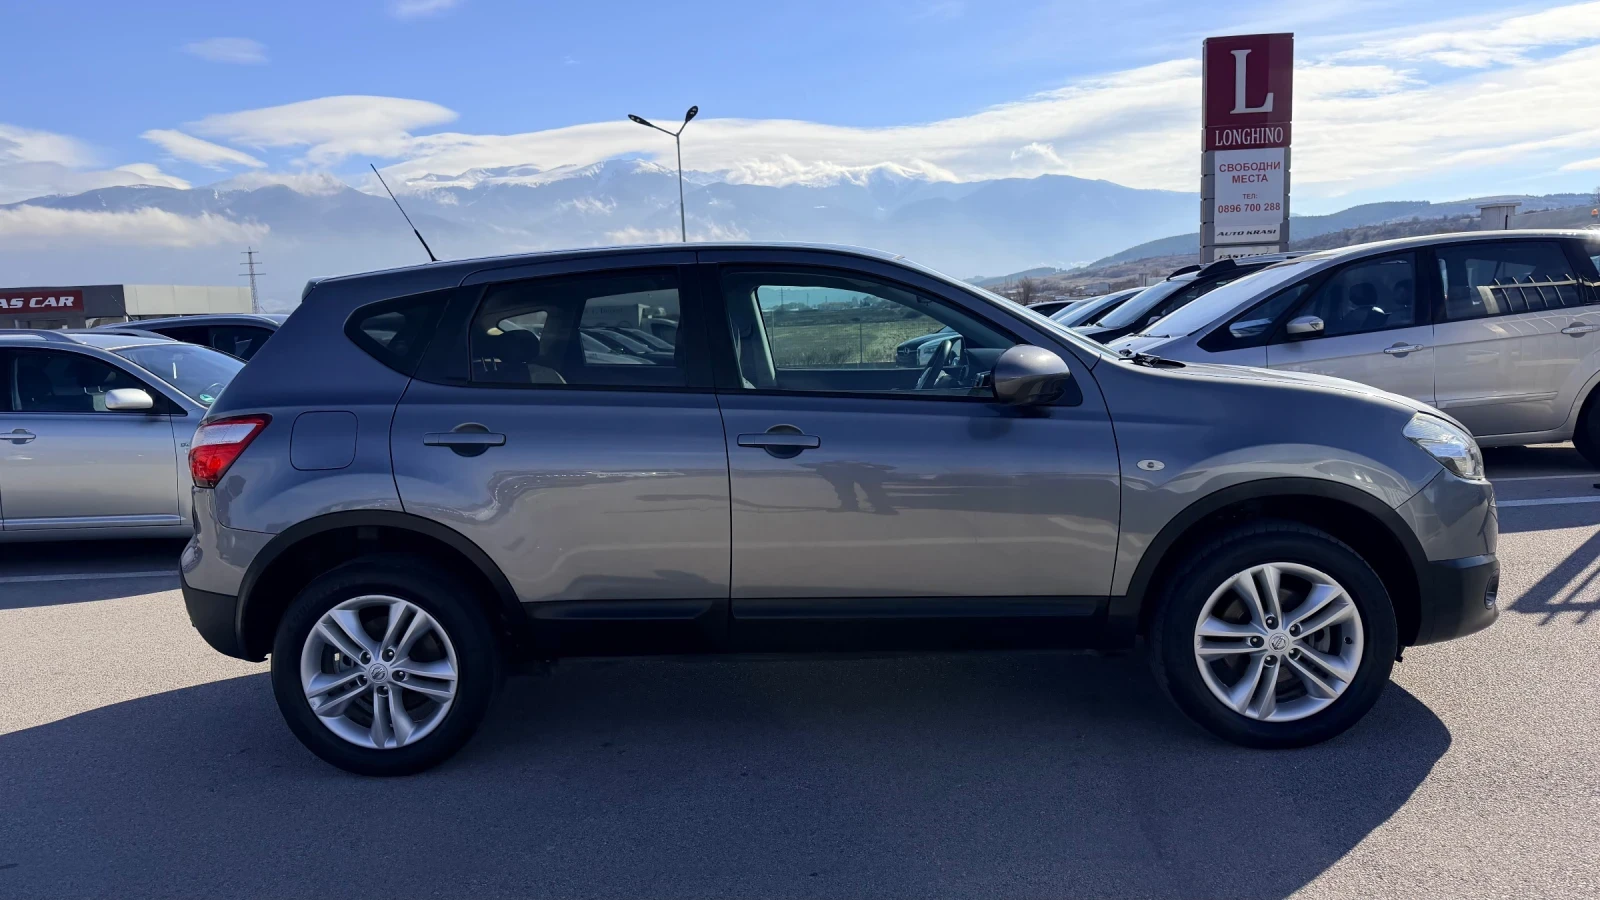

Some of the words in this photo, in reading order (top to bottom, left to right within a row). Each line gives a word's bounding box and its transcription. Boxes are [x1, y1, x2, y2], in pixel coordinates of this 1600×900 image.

[1229, 49, 1274, 115] L
[1215, 127, 1284, 146] LONGHINO
[1219, 161, 1281, 173] СВОБОДНИ
[1232, 174, 1268, 184] МЕСТА
[1218, 204, 1241, 213] 0896
[1244, 204, 1261, 212] 700
[1264, 202, 1280, 211] 288
[28, 296, 75, 308] CAR
